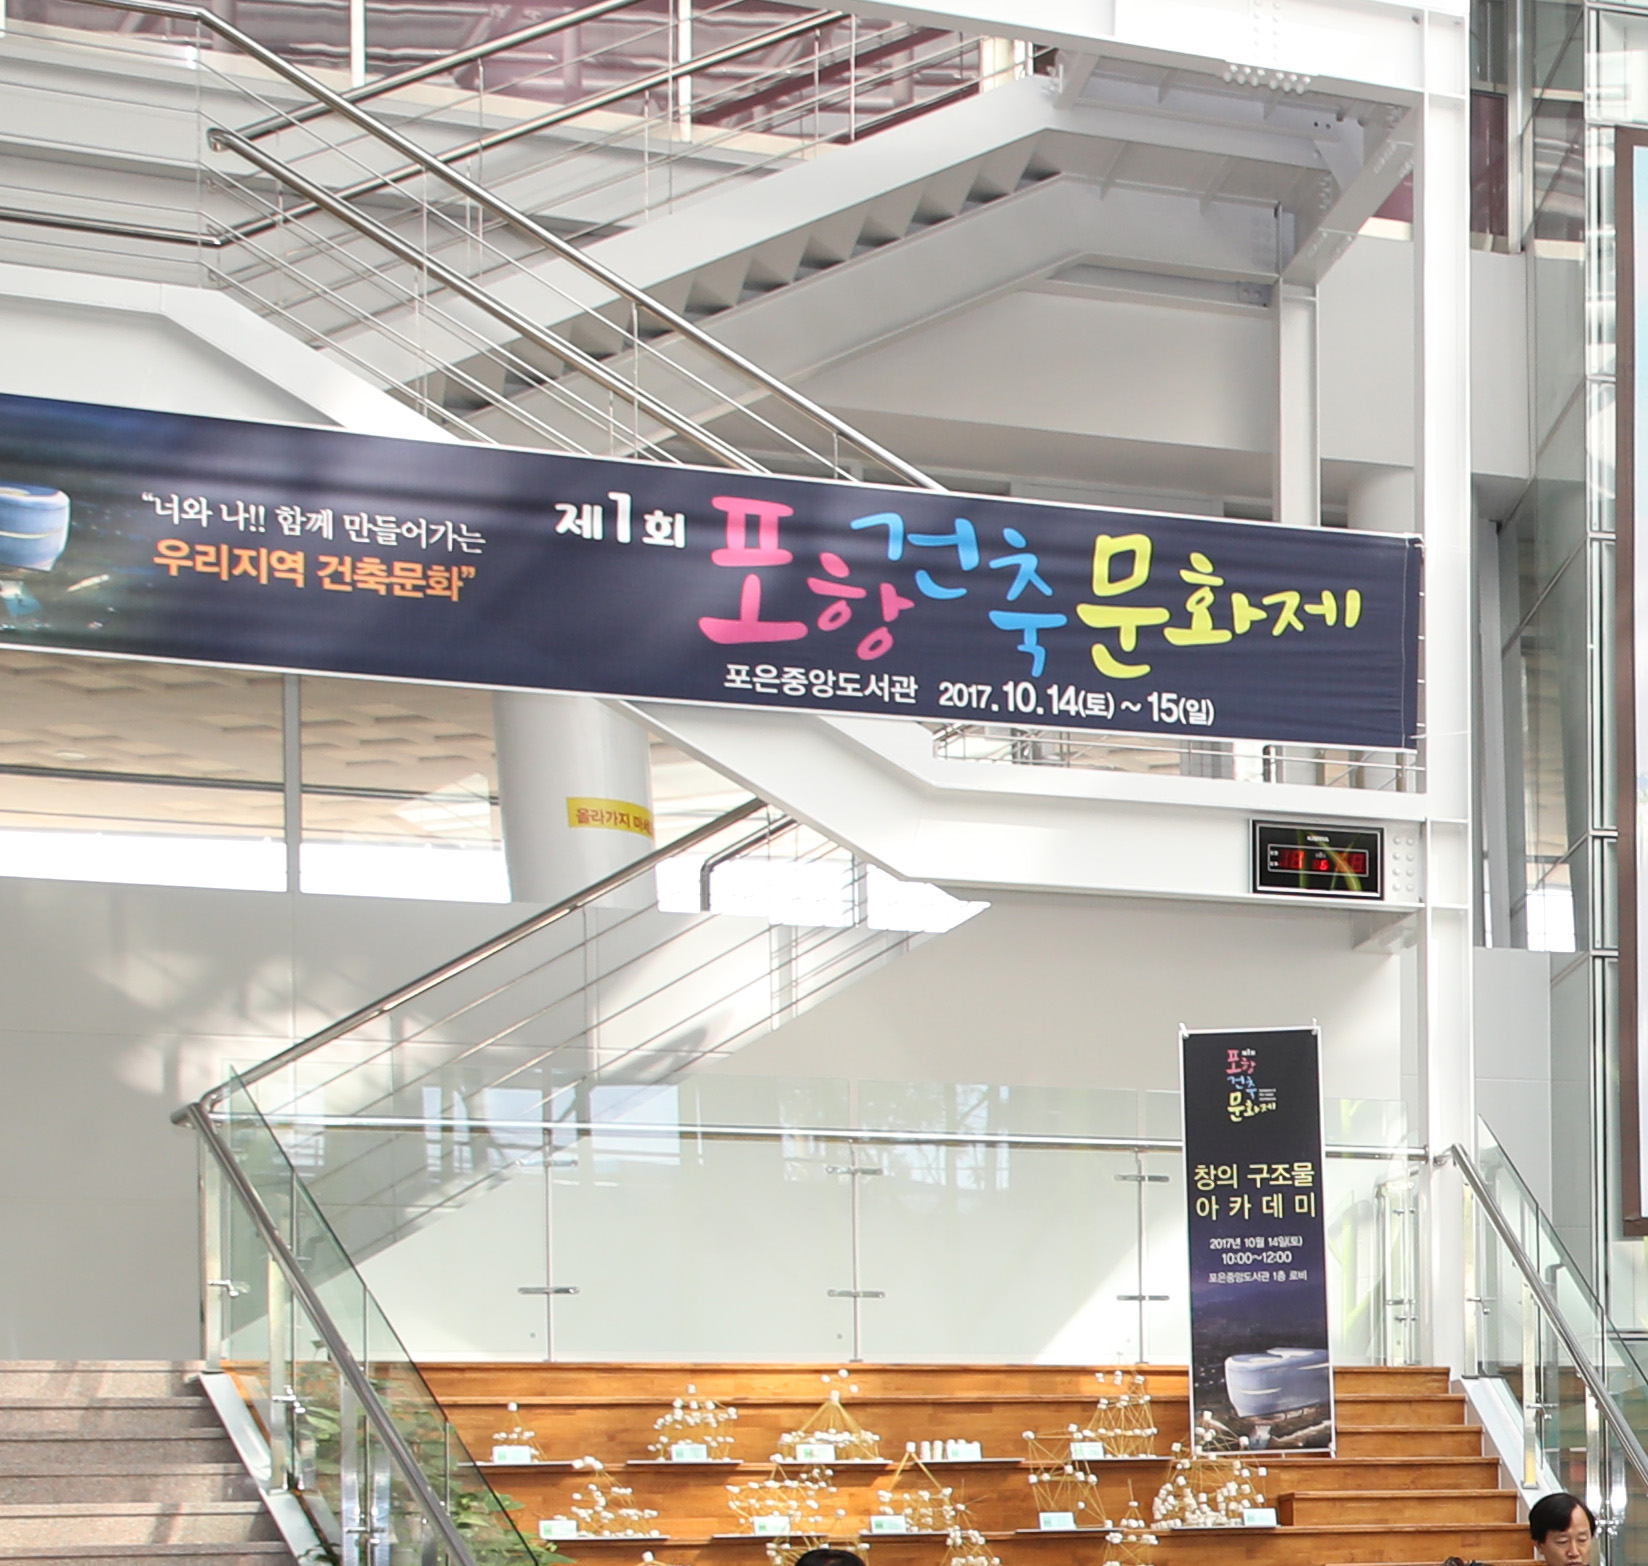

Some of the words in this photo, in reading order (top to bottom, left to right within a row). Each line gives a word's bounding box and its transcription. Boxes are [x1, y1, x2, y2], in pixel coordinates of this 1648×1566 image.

[141, 491, 211, 527] “너와
[219, 501, 264, 533] 나!!
[276, 504, 333, 537] 함께
[344, 510, 486, 554] 만들어가는
[554, 490, 687, 549] 제1회
[153, 538, 307, 587] 우리지역
[315, 557, 477, 602] 건축문화”
[723, 663, 918, 705] 포은중앙도서관
[1146, 692, 1216, 726] 15(일)
[576, 807, 631, 829] 올라가지
[1194, 1163, 1238, 1190] 창의
[1247, 1162, 1315, 1188] 구조물
[1209, 1236, 1241, 1249] 2017년
[1244, 1236, 1264, 1248] 10월
[1222, 1251, 1293, 1265] 10:00~12:00
[1208, 1270, 1270, 1283] 포은중앙도서관
[1289, 1270, 1307, 1281] 로비
